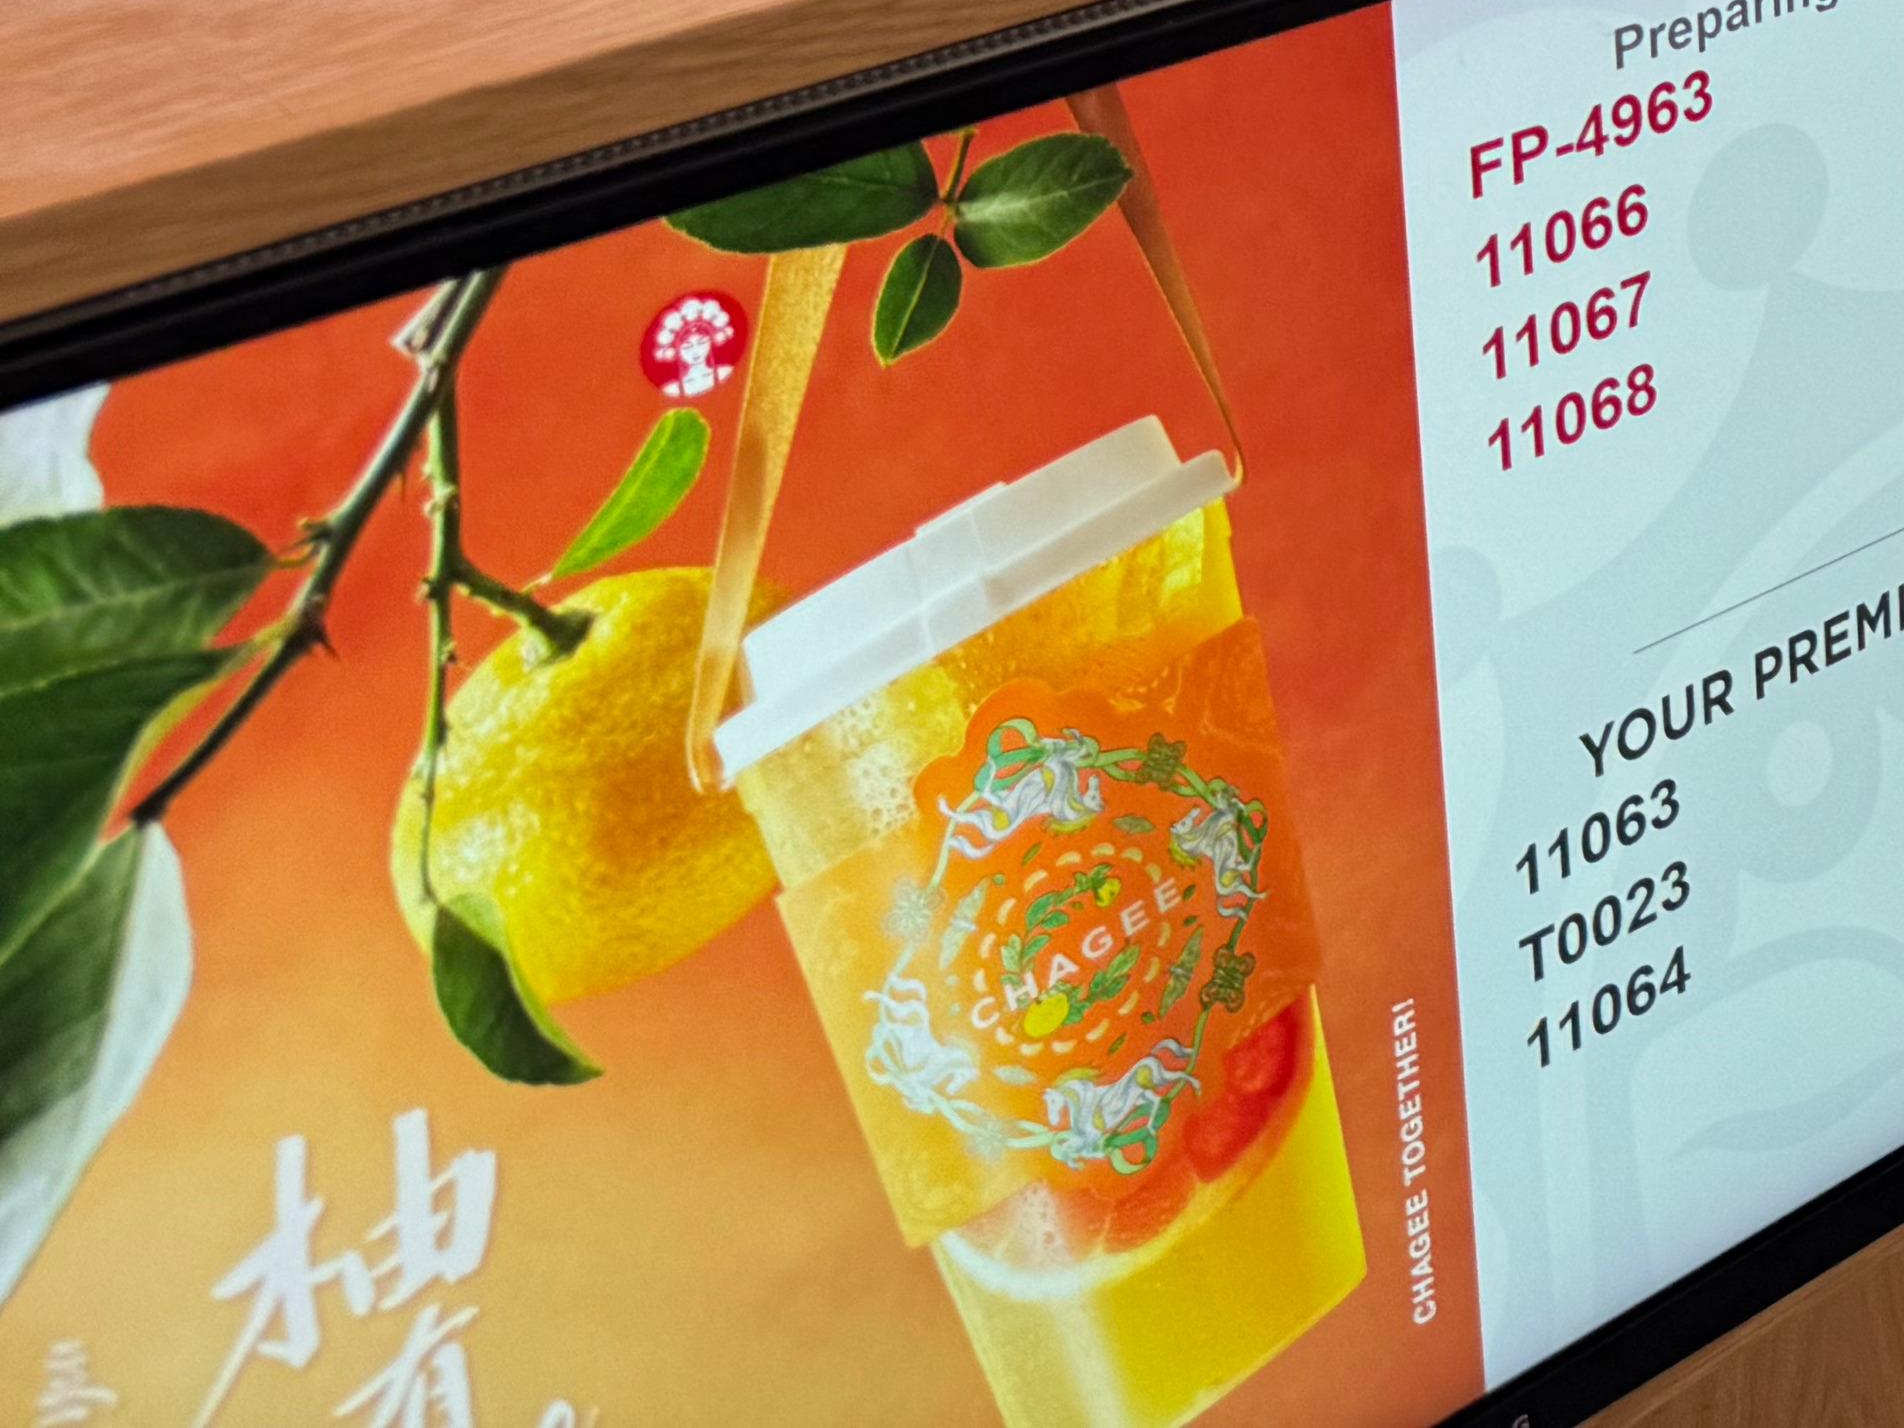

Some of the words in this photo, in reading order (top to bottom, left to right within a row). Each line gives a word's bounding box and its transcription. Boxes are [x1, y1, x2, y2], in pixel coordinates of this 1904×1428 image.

[1468, 70, 1715, 199] FP-4963
[1475, 184, 1649, 289] 11066
[1481, 272, 1653, 380] 11067
[1487, 364, 1657, 472] 11068
[1577, 668, 1735, 779] YOUR
[1514, 778, 1680, 896] 11063
[970, 877, 1182, 1029] CHAGEE
[1518, 861, 1692, 984] T0023
[1525, 947, 1692, 1070] 11064
[1392, 997, 1426, 1187] TOGETHER!
[1406, 1188, 1437, 1327] CHAGEE
